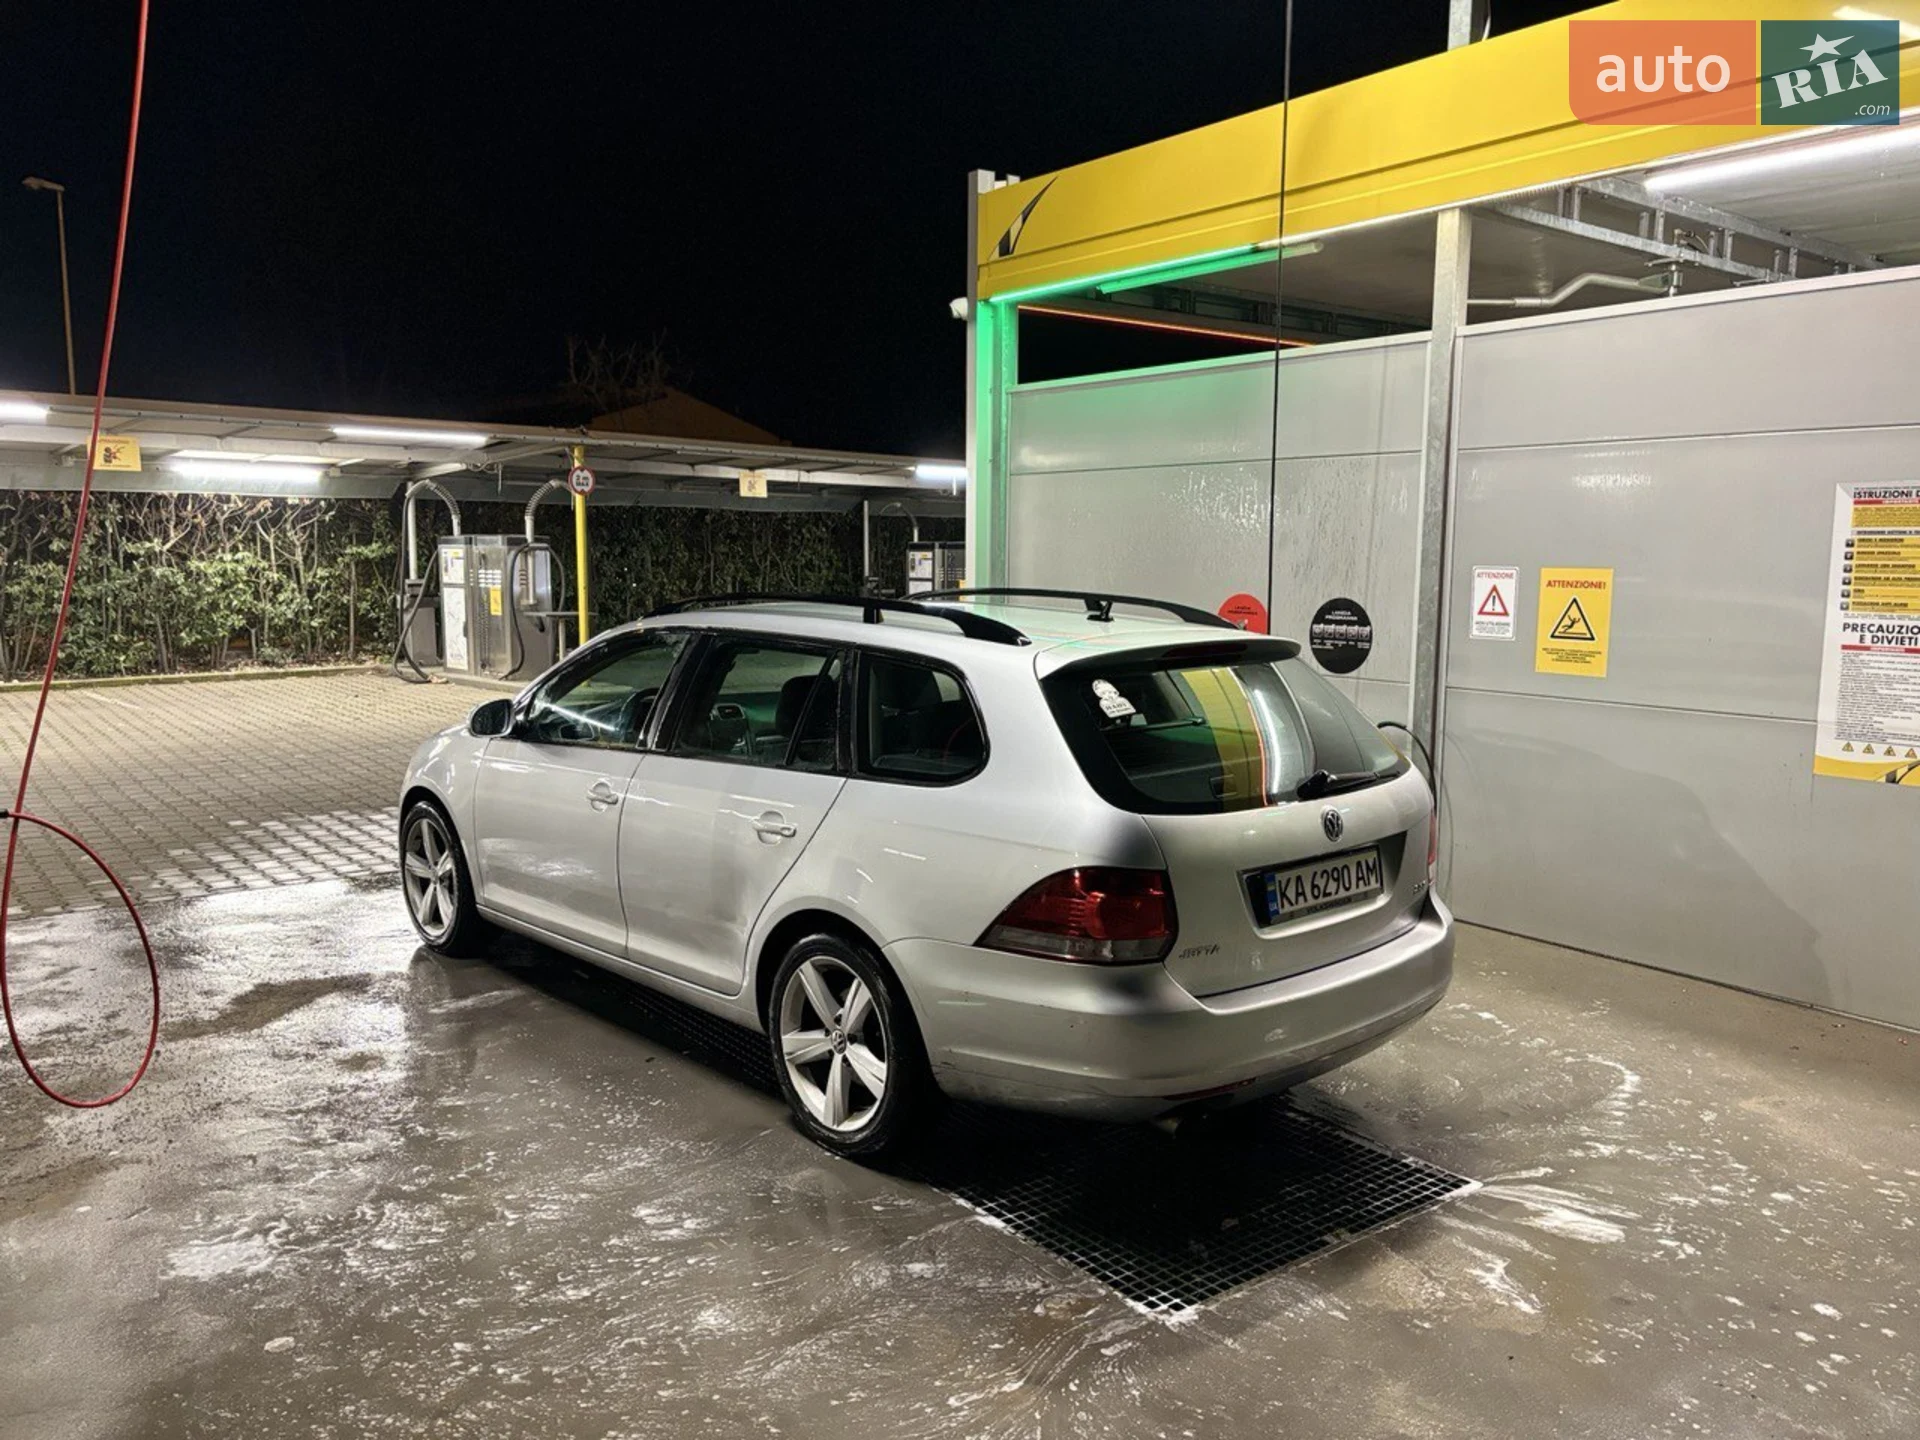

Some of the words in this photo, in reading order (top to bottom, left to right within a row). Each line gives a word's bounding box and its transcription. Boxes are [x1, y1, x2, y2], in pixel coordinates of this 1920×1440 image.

[1853, 490, 1913, 499] ISTRUZIONI
[1477, 571, 1513, 579] ATTENZIONE
[1546, 580, 1606, 590] ATTENZIONE!
[1843, 622, 1920, 636] PRECAUZIO
[1859, 634, 1866, 644] E
[1871, 634, 1918, 647] DIVIETI
[1278, 874, 1308, 909] KA
[1311, 864, 1352, 899] 6290
[1356, 857, 1379, 889] AM
